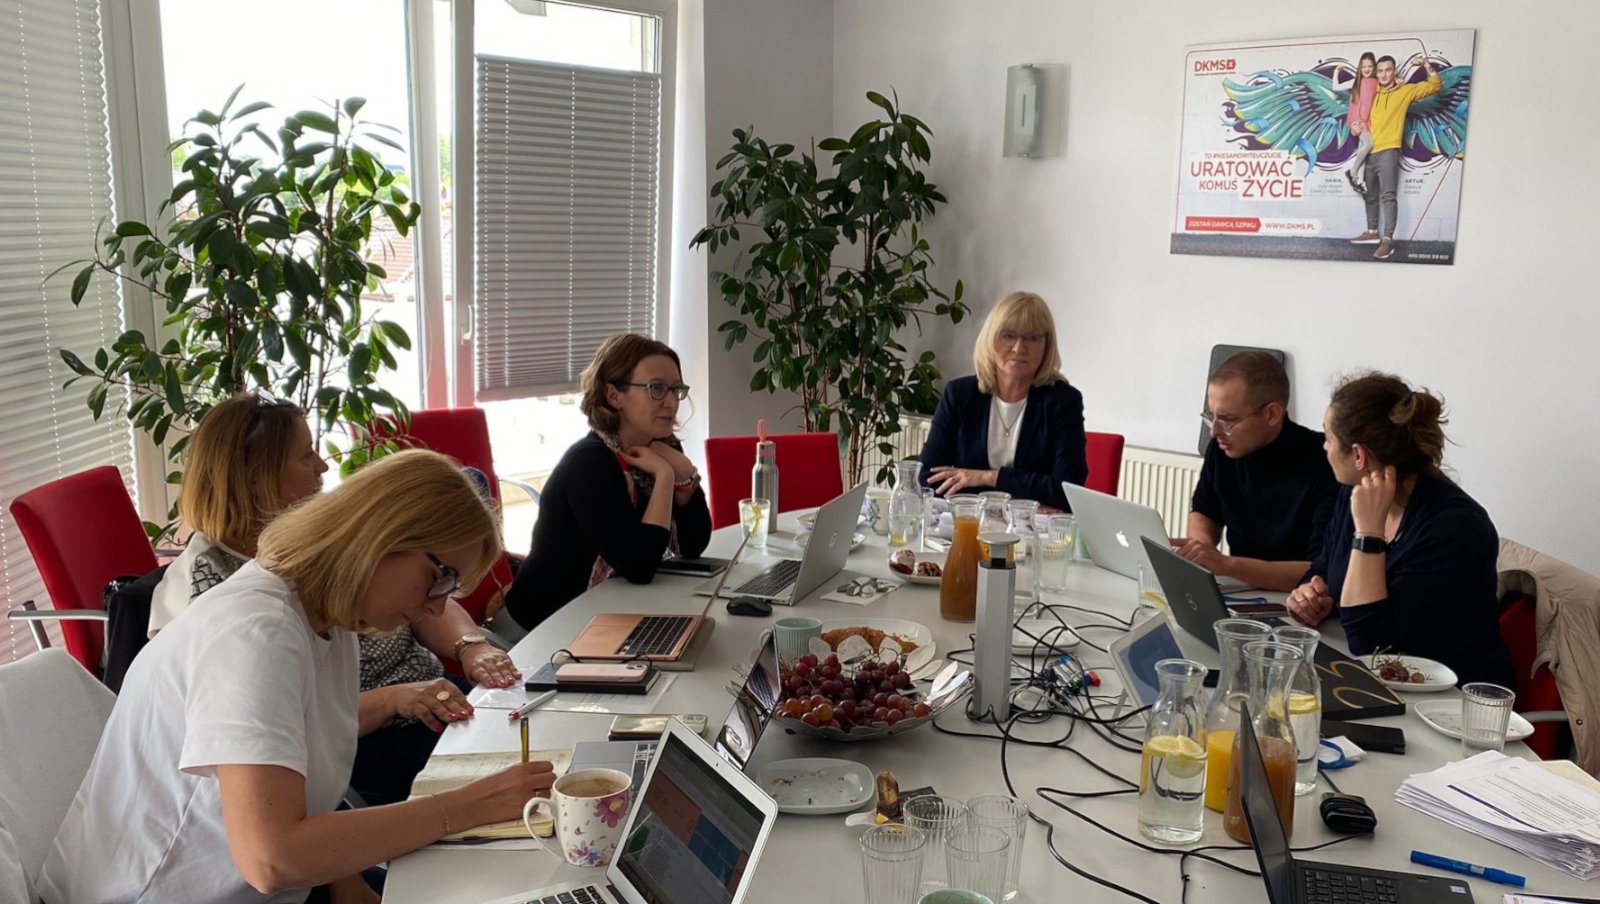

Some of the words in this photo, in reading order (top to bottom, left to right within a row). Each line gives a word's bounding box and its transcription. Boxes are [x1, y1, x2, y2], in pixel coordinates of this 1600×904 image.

[1194, 60, 1226, 72] DKMS
[1190, 156, 1293, 177] URATOWAĆ
[1199, 178, 1238, 190] KOMUŚ
[1242, 175, 1303, 198] ŻYCIE
